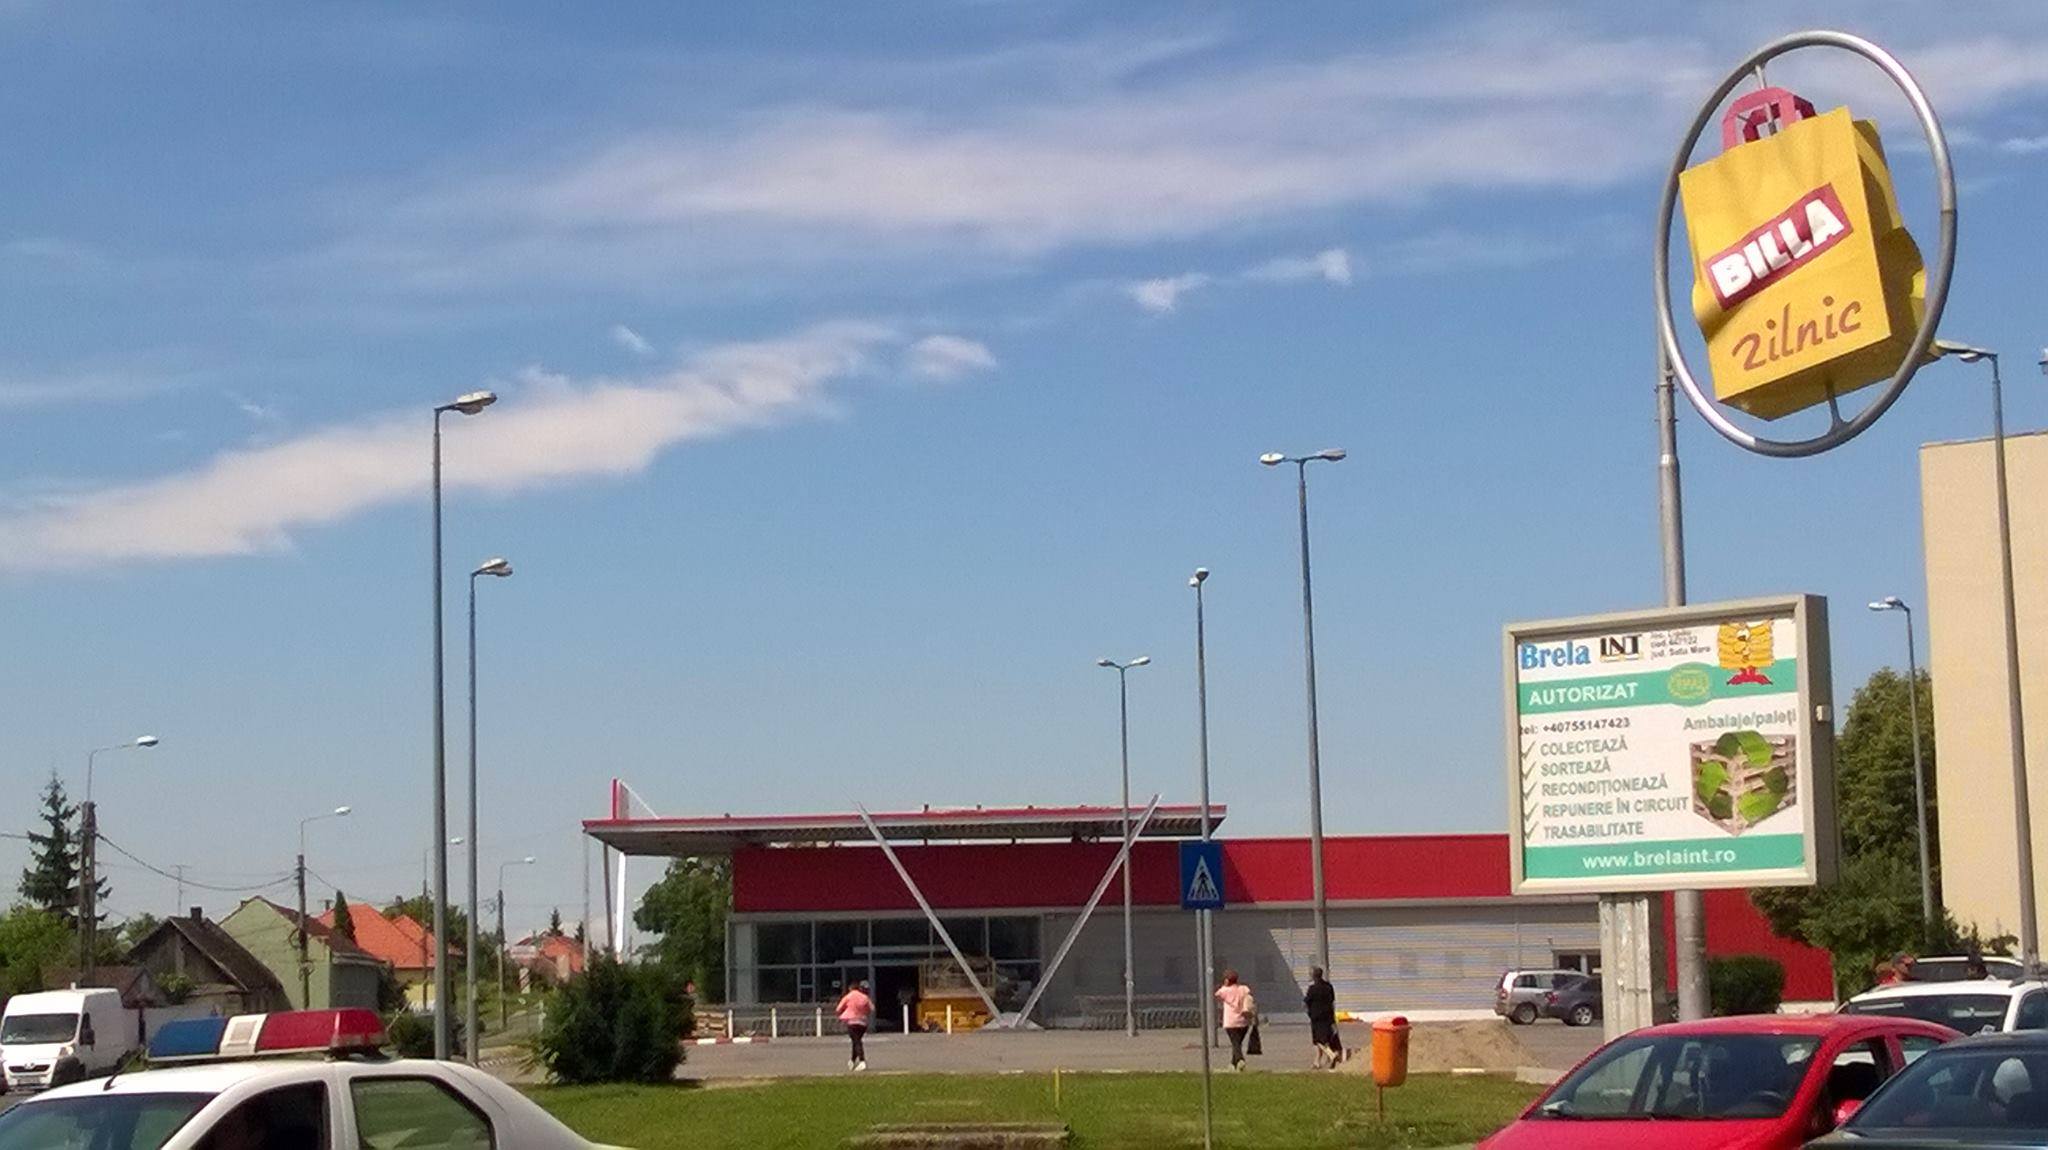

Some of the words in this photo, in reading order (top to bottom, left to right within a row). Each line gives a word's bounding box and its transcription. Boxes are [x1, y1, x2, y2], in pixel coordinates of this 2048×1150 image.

[1711, 199, 1844, 298] BILLA
[1521, 641, 1591, 670] Brela
[1600, 634, 1642, 657] INT
[1529, 682, 1638, 705] AUTORIZAT
[1543, 717, 1630, 733] +40755147423
[1540, 735, 1628, 756] COLECTEAZĂ
[1540, 756, 1611, 777] SORTEAZĂ
[1543, 801, 1613, 818] REPUNERE
[1616, 797, 1630, 814] ÎN
[1634, 796, 1689, 813] CIRCUIT
[1544, 821, 1644, 839] TRASABILITATE
[1582, 849, 1736, 869] www.brelaint.ro
